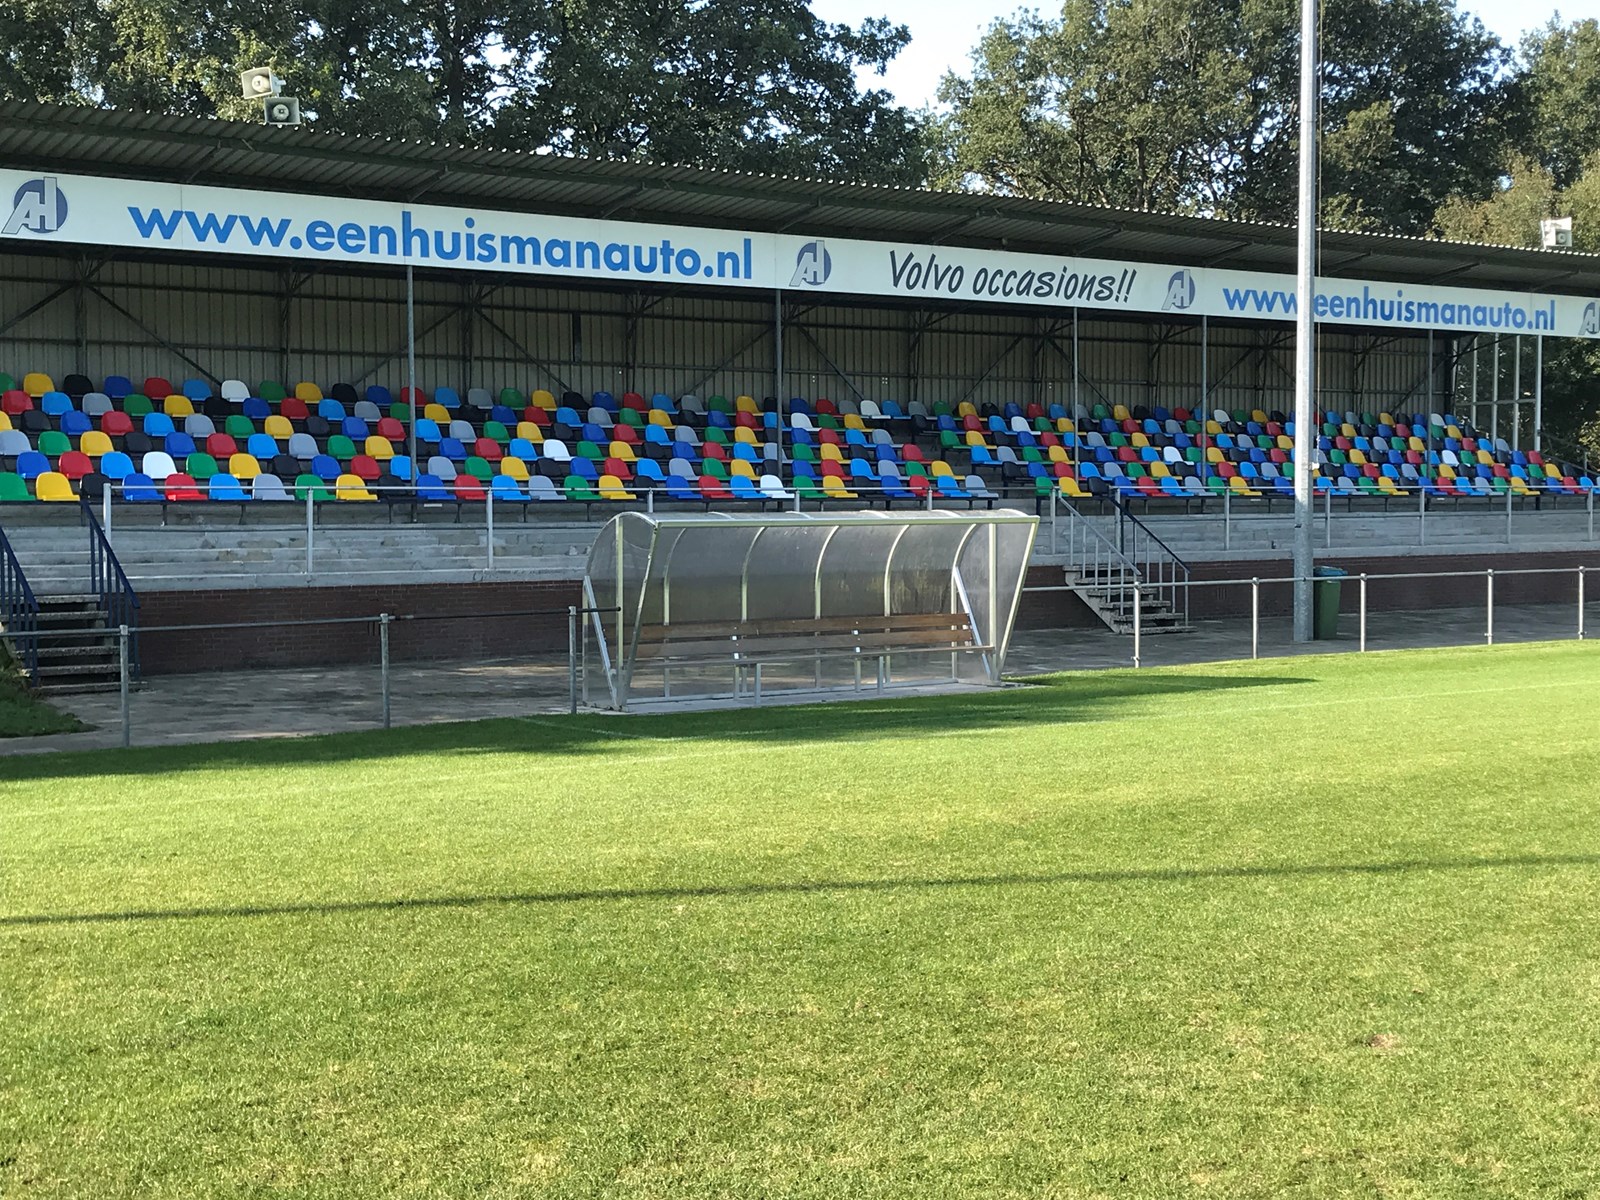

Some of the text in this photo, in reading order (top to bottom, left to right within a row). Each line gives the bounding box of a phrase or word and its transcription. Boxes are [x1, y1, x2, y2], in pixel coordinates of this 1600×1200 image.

[127, 206, 752, 280] www.eenhuismanauto.nl
[889, 249, 1137, 303] Volvo occasions!!
[1222, 286, 1555, 331] wwweenhuismanauto.nl
